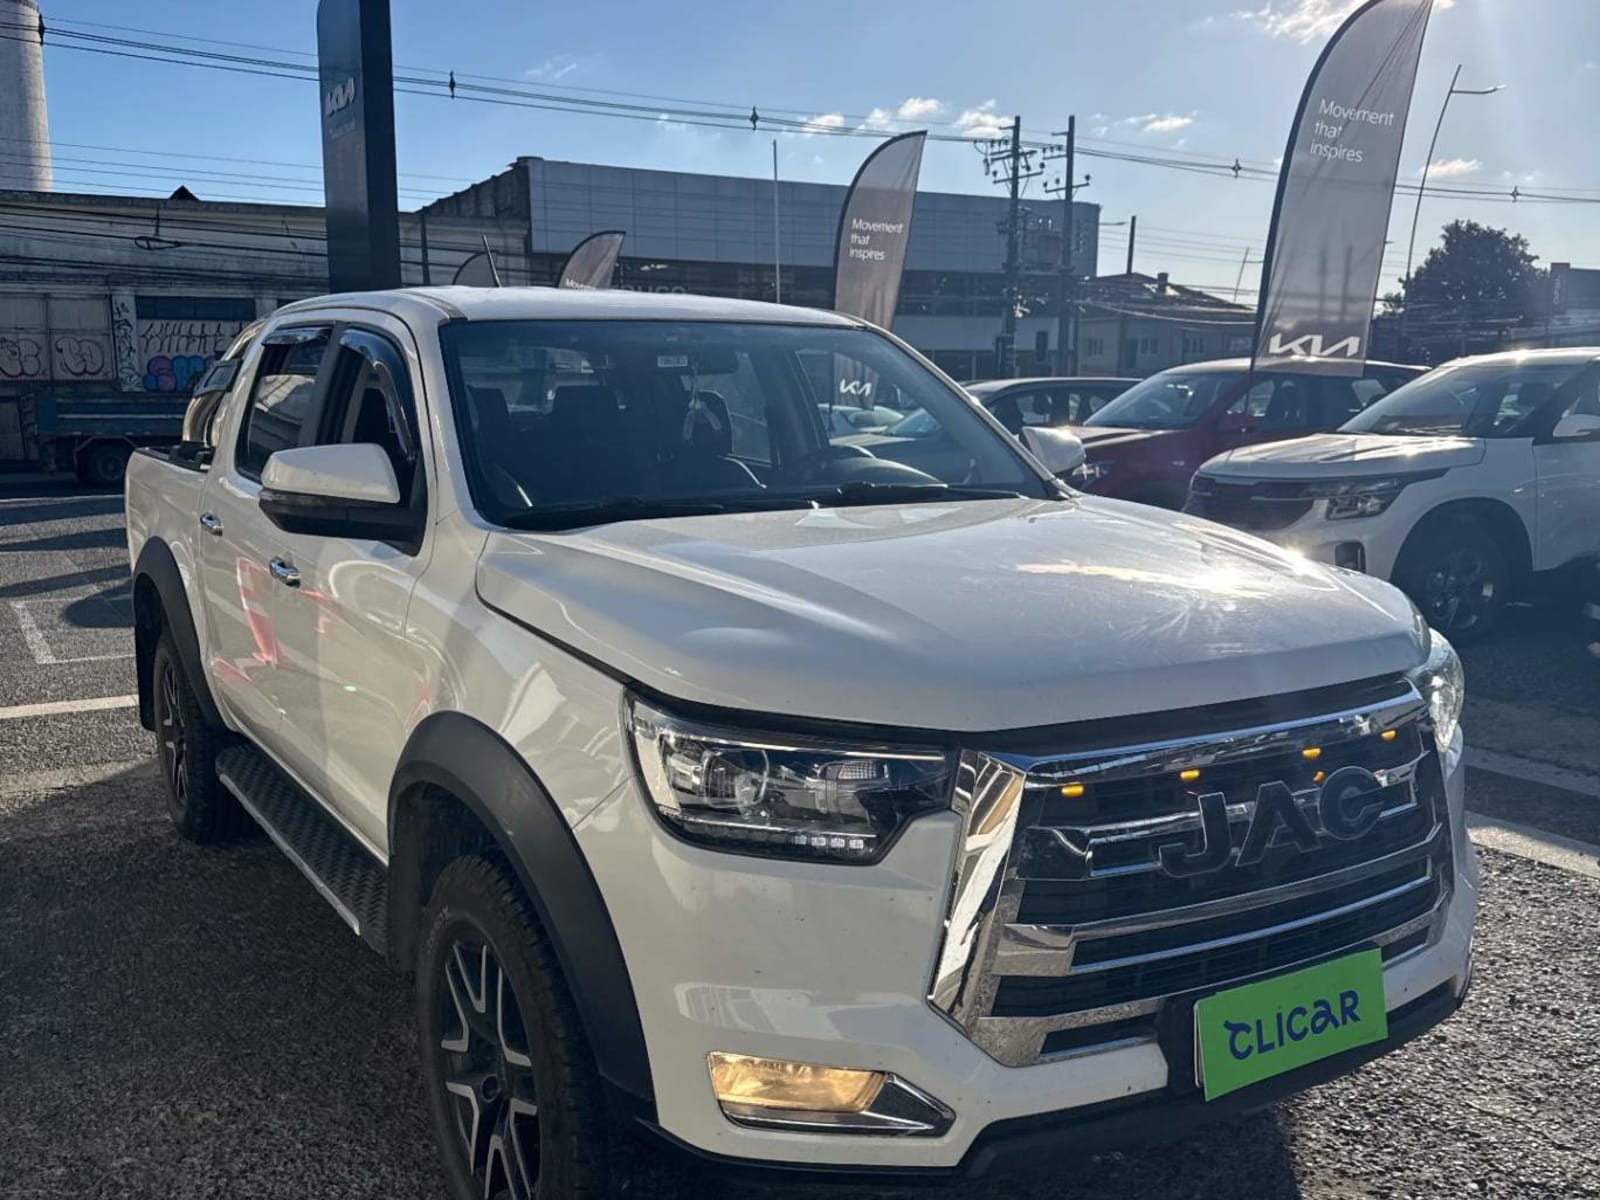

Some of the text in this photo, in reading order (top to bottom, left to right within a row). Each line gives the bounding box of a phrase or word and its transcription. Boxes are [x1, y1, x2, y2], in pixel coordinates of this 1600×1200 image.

[325, 77, 355, 116] KIA
[1319, 98, 1395, 126] Movement
[1314, 120, 1343, 139] that
[1310, 138, 1364, 162] inspires
[852, 217, 903, 234] Movement
[850, 233, 870, 245] that
[849, 247, 885, 261] inspires
[1269, 333, 1360, 357] KIA
[840, 379, 872, 396] KIA
[1158, 765, 1385, 878] JAC
